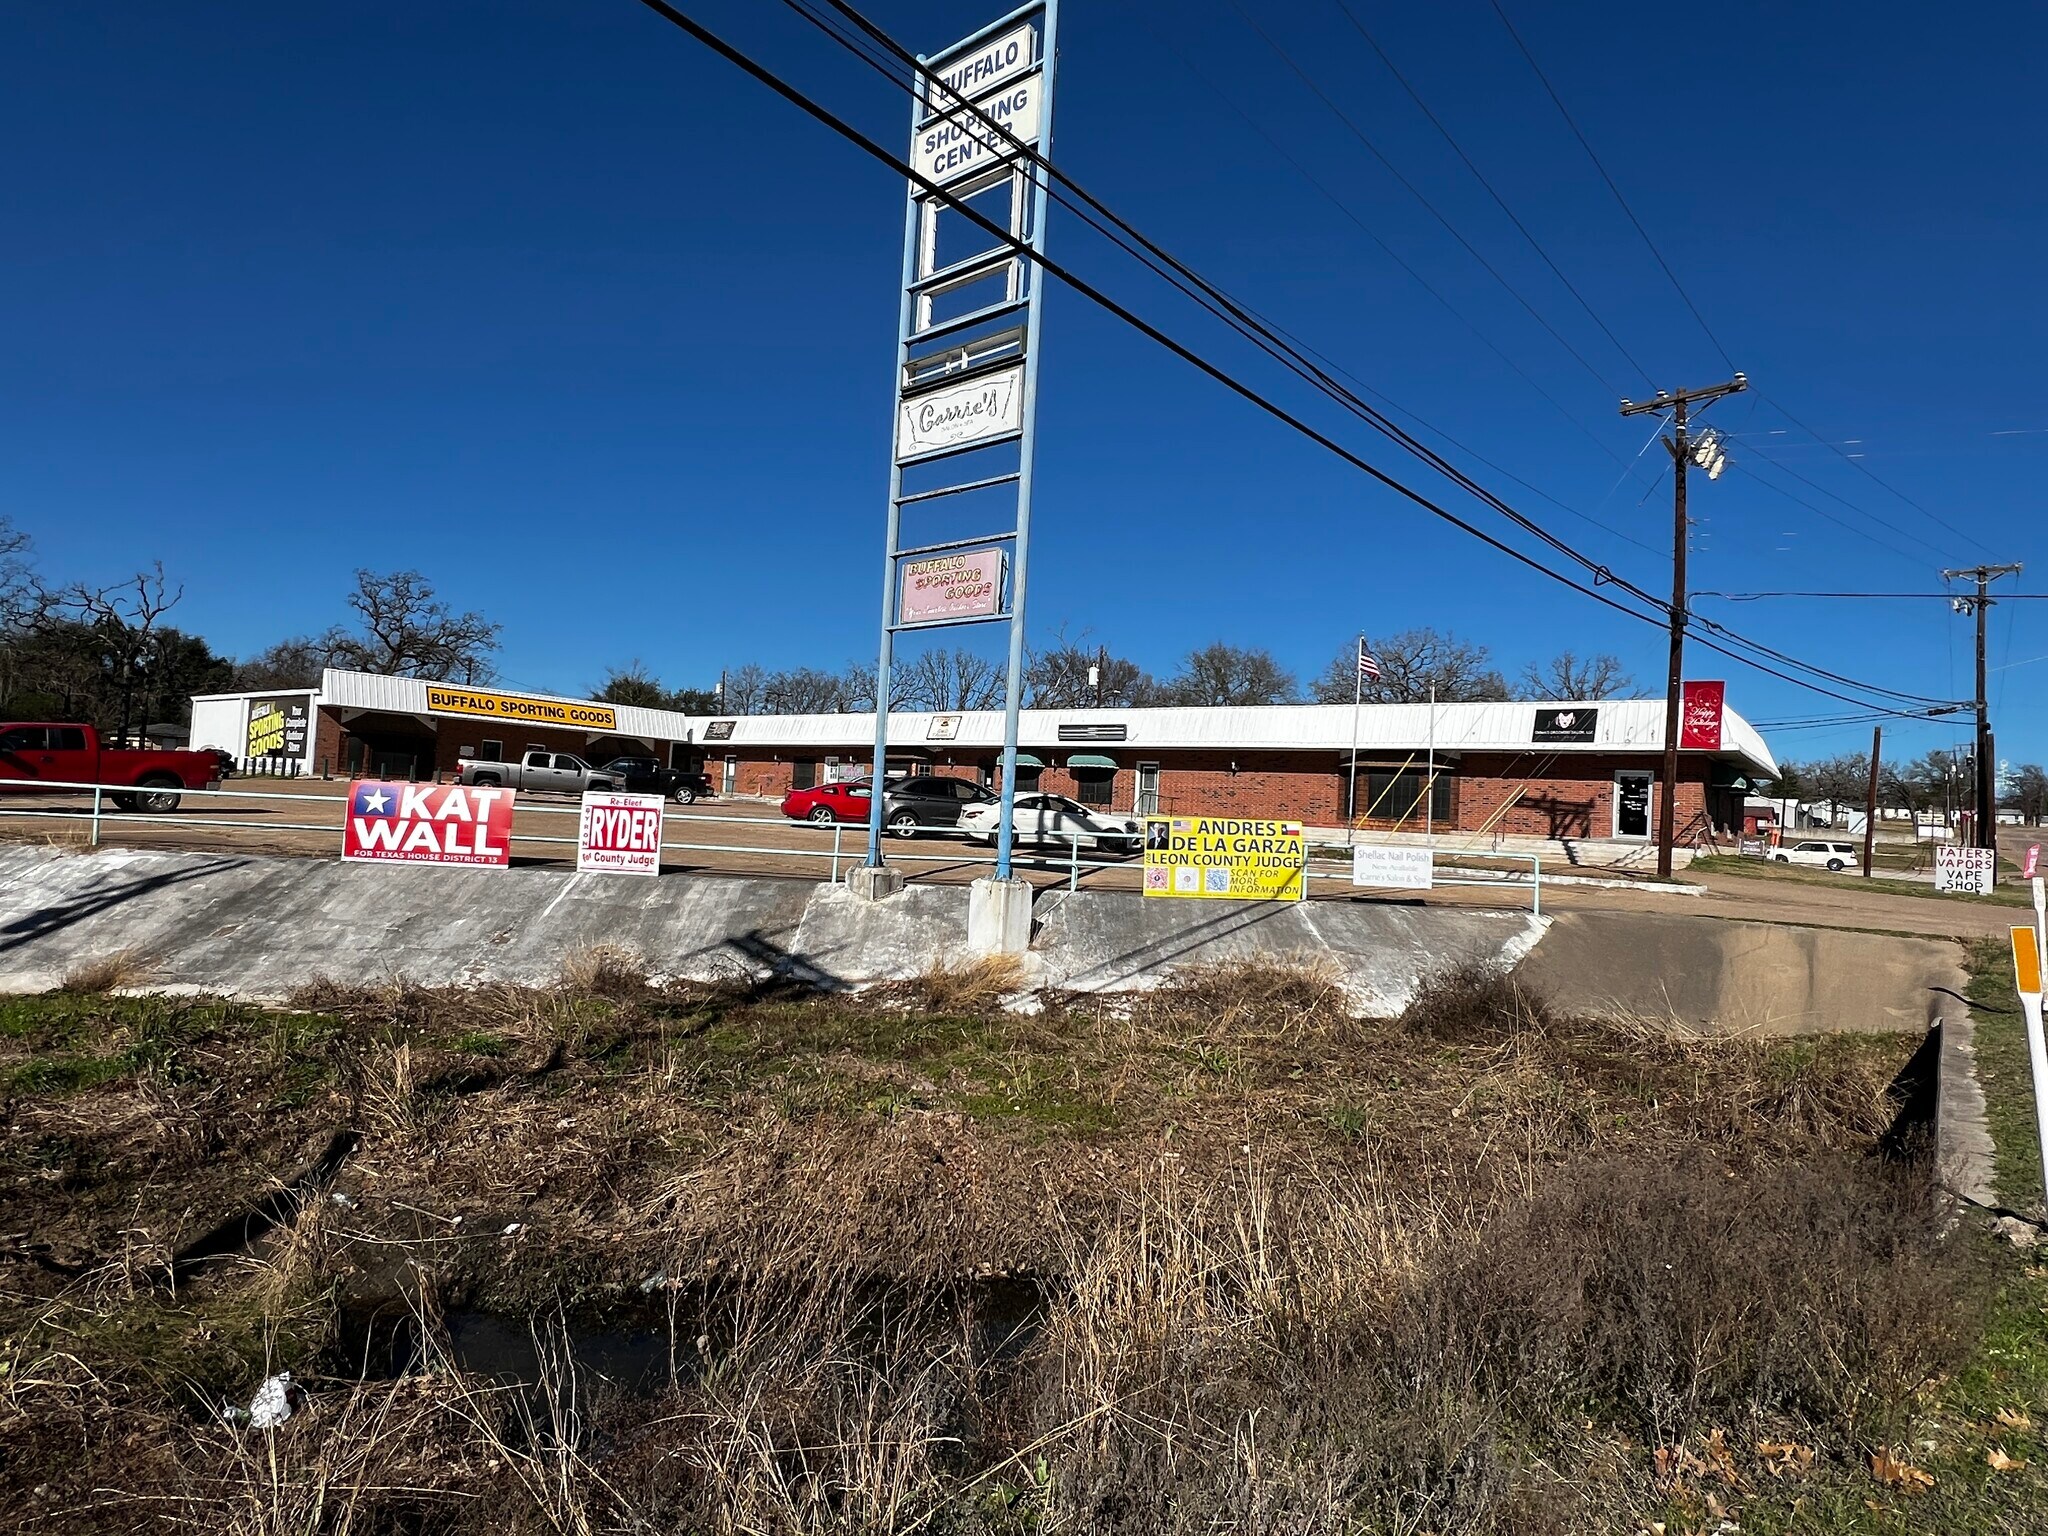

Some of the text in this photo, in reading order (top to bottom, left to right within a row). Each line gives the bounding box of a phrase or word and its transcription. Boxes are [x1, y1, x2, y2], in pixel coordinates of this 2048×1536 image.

[940, 41, 1018, 101] BUFFALO
[920, 389, 997, 432] Carrie's
[908, 555, 966, 576] BUFFALO
[915, 568, 982, 590] SPORTING
[944, 582, 992, 600] GOODS
[431, 693, 612, 724] BUFFALO SPORTING GOODS
[1690, 706, 1715, 718] Happy
[249, 710, 284, 740] SPORTING
[249, 730, 284, 758] GOODS
[400, 786, 502, 822] KAT
[610, 798, 642, 806] Re-Elect
[590, 808, 657, 850] RYDER
[1198, 820, 1276, 836] ANDRES
[354, 818, 502, 856] WALL
[1172, 836, 1300, 854] DE LA GARZA
[376, 851, 404, 859] TEXAS
[407, 852, 440, 861] HOUSE
[443, 854, 485, 862] DISTRICT
[594, 852, 625, 865] County
[628, 854, 654, 866] Judge
[1152, 853, 1300, 868] LEON COUNTY JUDGE
[1358, 850, 1429, 862] Shellac Nail Polish
[1939, 848, 1992, 859] TATERS
[1937, 859, 1992, 870] VAPORS
[1230, 869, 1279, 878] SCAN FOR
[1946, 870, 1982, 881] VAPE
[1230, 886, 1299, 894] INFORMATION
[1946, 880, 1983, 891] SHOP
